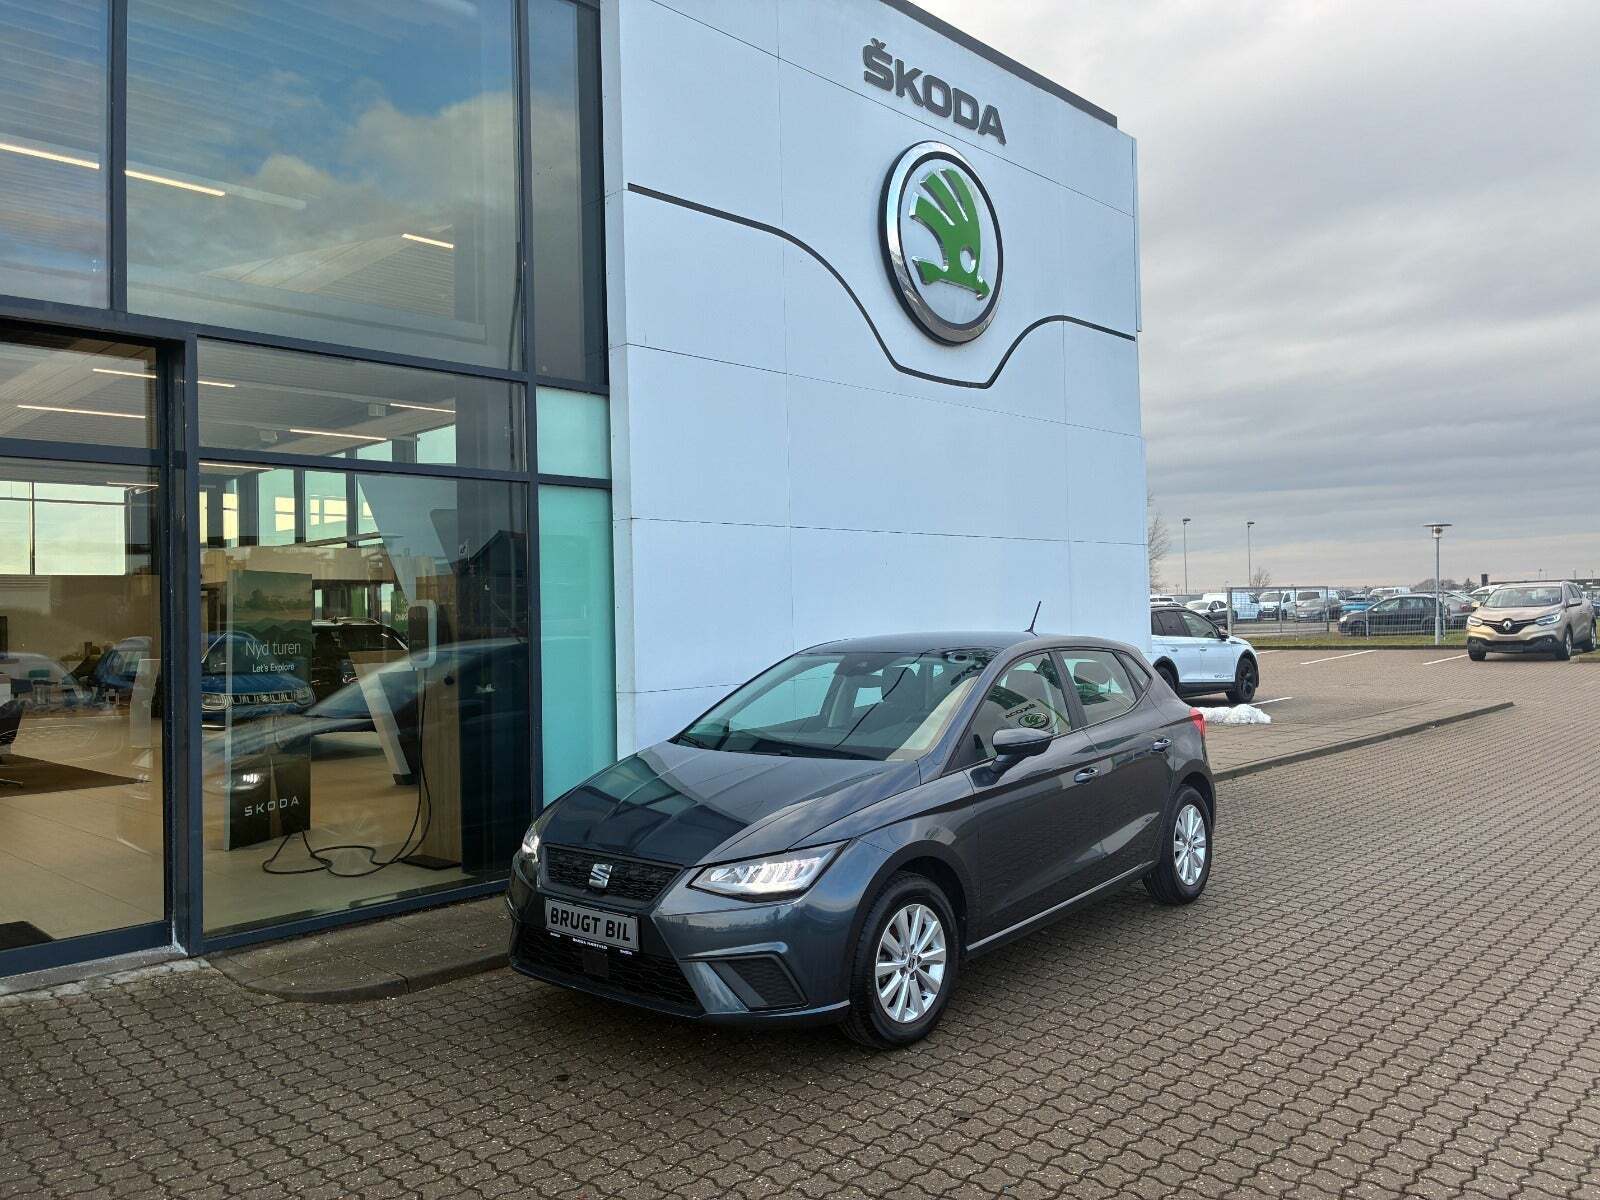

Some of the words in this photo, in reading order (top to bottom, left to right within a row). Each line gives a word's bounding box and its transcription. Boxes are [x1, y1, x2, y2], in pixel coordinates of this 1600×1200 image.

[862, 37, 1007, 146] ŠKODA
[245, 640, 269, 660] Nyd
[272, 641, 301, 656] turen
[252, 663, 269, 673] Let's
[270, 663, 295, 674] Explore
[550, 907, 601, 934] BRUGT
[605, 919, 631, 942] BIL
